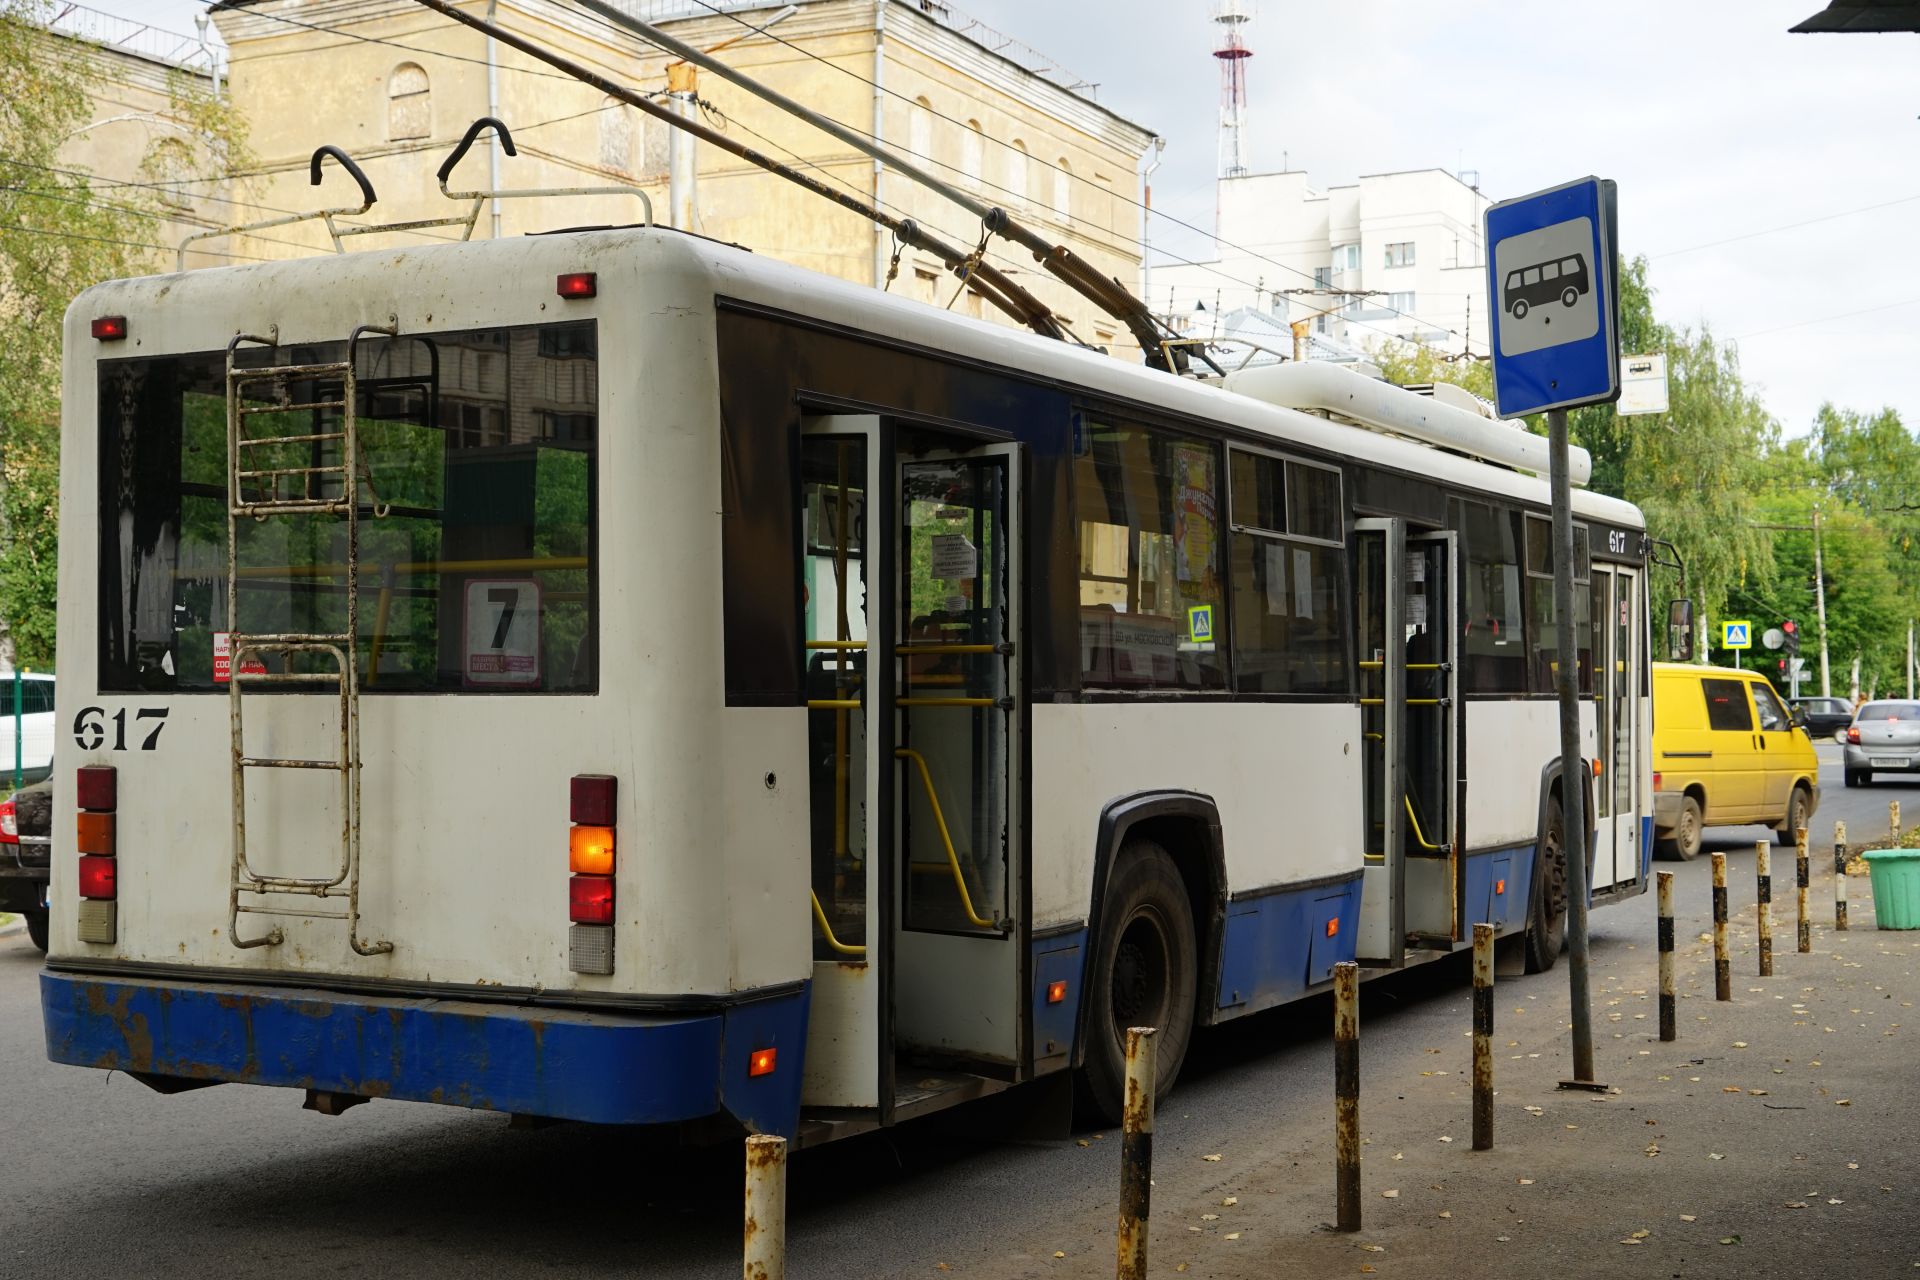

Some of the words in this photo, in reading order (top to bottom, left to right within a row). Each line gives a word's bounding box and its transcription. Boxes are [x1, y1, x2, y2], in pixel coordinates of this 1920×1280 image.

[1609, 530, 1625, 553] 617
[487, 588, 519, 649] 7
[73, 706, 169, 751] 617
